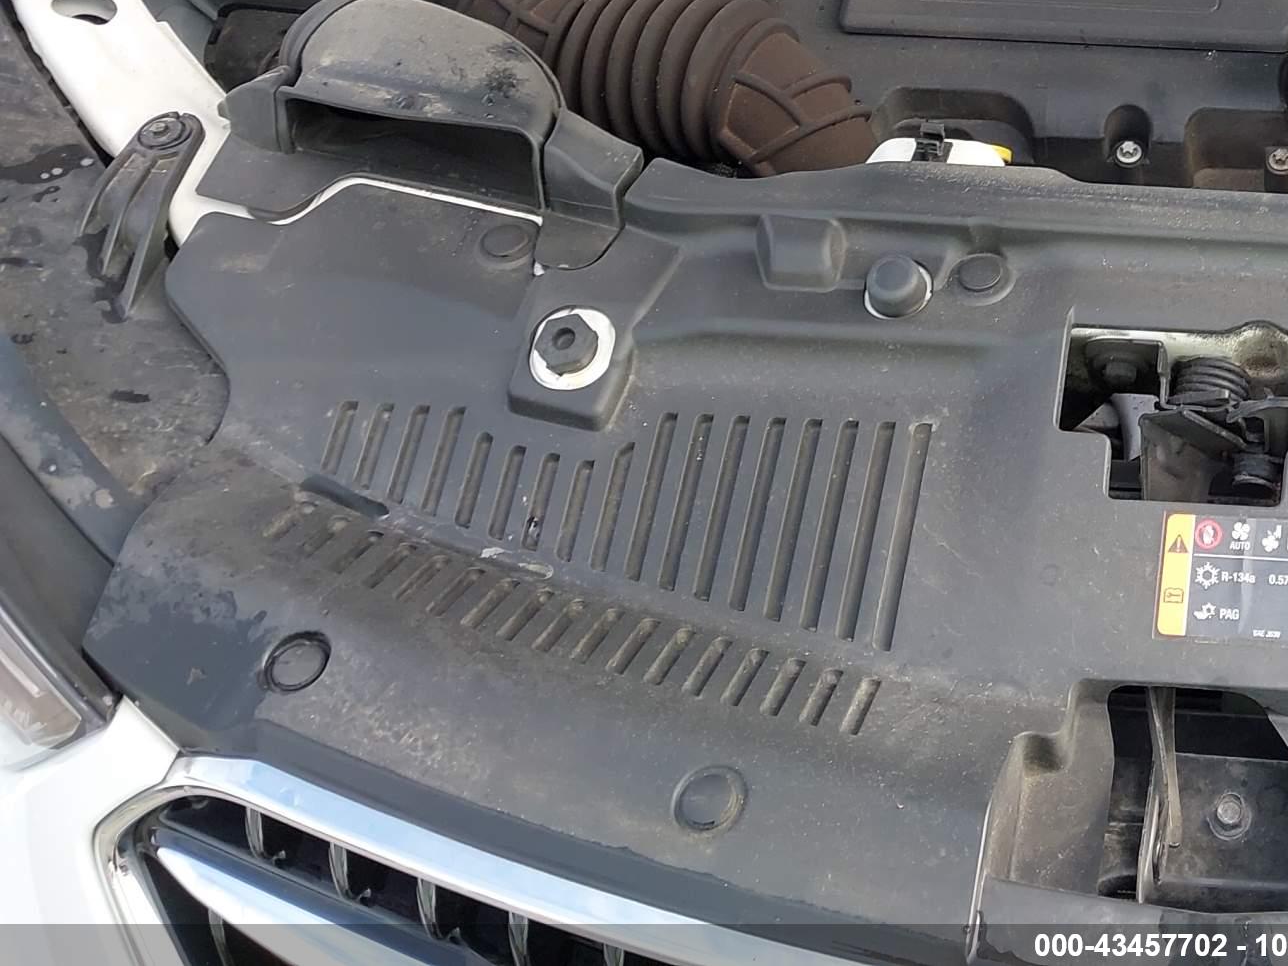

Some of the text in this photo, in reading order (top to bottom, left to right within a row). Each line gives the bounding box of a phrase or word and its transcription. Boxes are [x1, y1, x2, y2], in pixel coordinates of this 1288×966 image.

[1229, 541, 1250, 551] AUTO
[1221, 571, 1256, 584] R-134a
[1219, 608, 1240, 620] PAG
